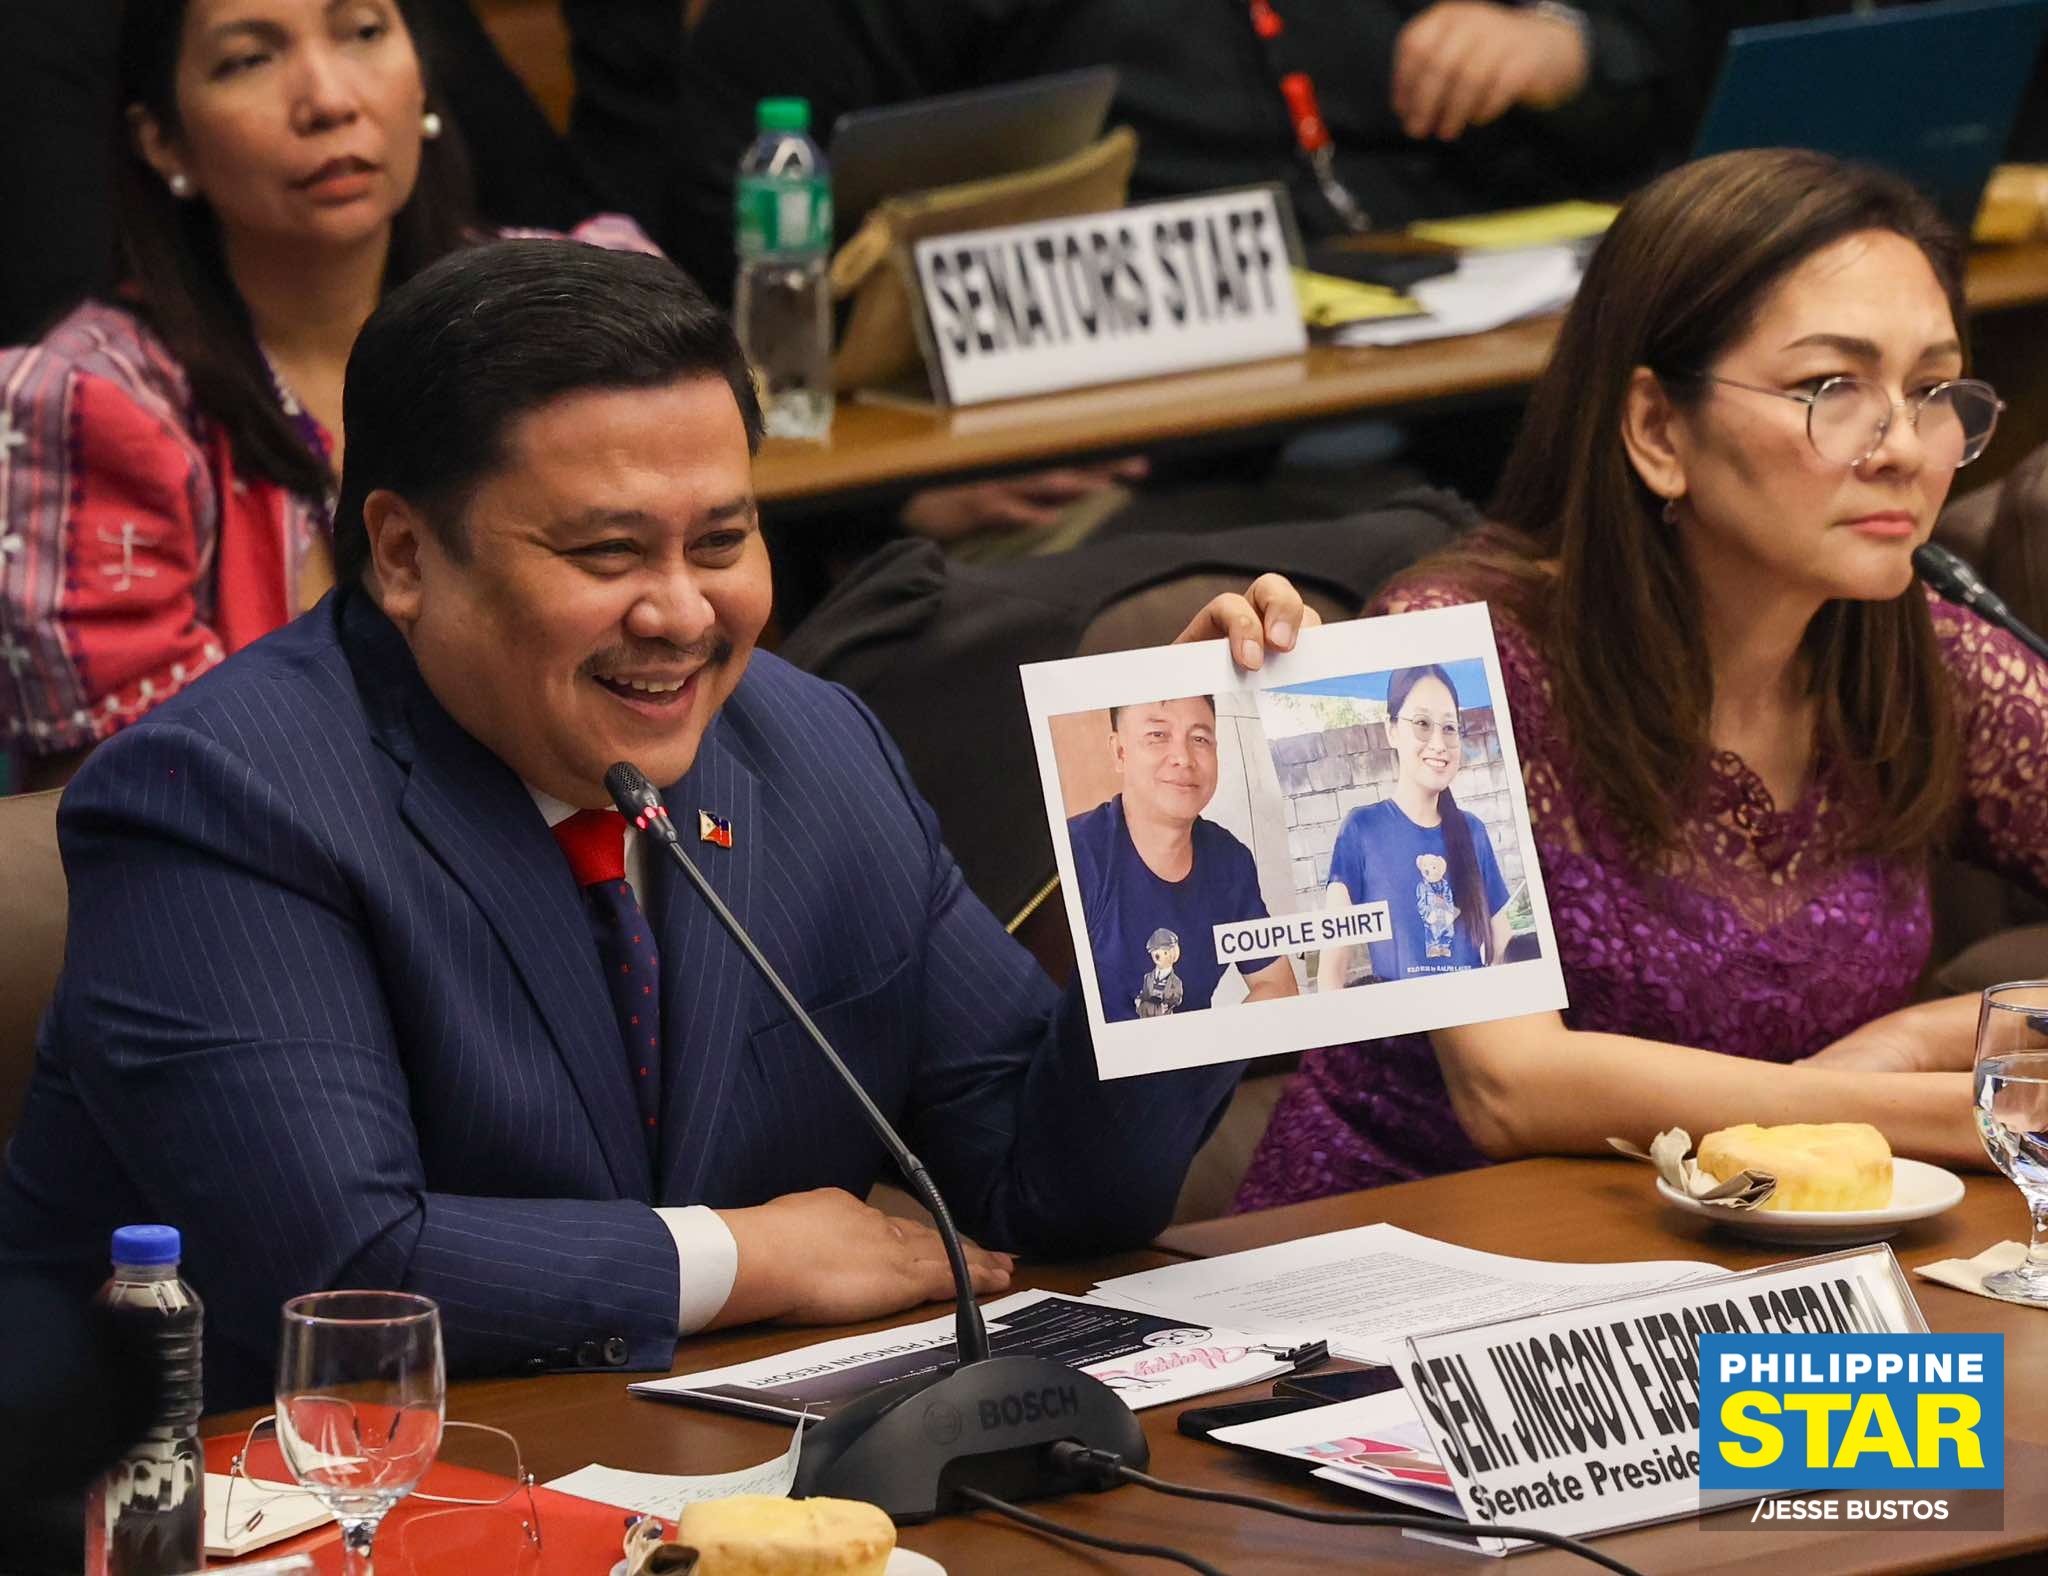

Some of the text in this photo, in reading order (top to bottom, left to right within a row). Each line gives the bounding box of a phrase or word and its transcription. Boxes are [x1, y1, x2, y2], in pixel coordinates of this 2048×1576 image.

[931, 209, 1275, 358] SENATORS STAFF
[1221, 911, 1385, 954] COUPLE SHIRT
[751, 1342, 922, 1388] PENGUIN RESORT
[978, 1385, 1079, 1431] BOSCH
[1411, 1353, 1519, 1479] SEN.
[1487, 1326, 1645, 1464] JINGGOY
[1469, 1444, 1700, 1521] Senate Preside
